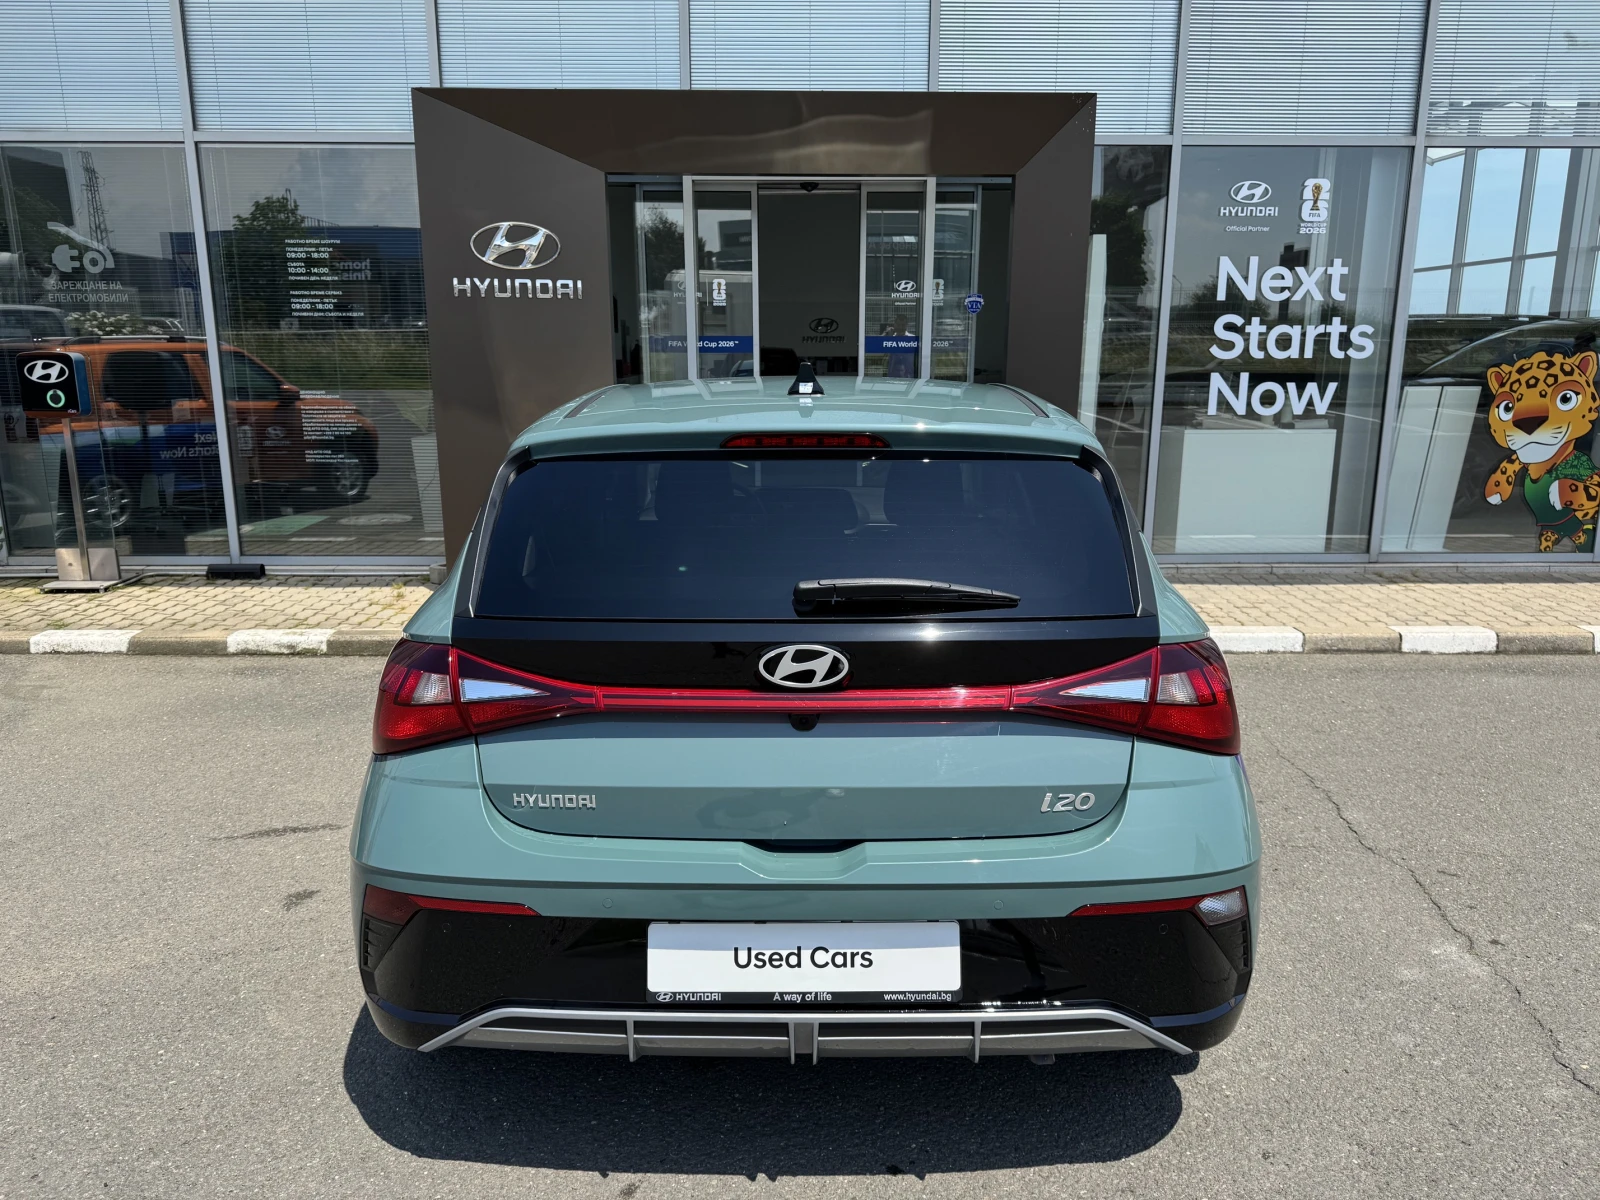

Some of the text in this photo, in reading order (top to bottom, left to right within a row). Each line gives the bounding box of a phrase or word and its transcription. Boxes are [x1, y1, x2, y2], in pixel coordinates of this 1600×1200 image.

[1220, 206, 1279, 217] HYUNDAI
[51, 281, 123, 291] ЗАРЕЖДАНЕ НА
[1216, 256, 1349, 301] Next
[453, 277, 582, 299] HYUNDAI
[49, 293, 129, 303] ЕЛЕКТРОМОБИЛИ
[802, 335, 845, 343] HYUNDAI
[1209, 313, 1375, 360] Starts
[703, 341, 718, 349] Cup
[1207, 372, 1338, 416] Now
[513, 793, 596, 809] HYUNDAI
[1040, 792, 1096, 813] i20
[733, 946, 874, 969] Used Cars
[676, 992, 952, 1003] HYUNDAI A way of life www.hyundai.bg
